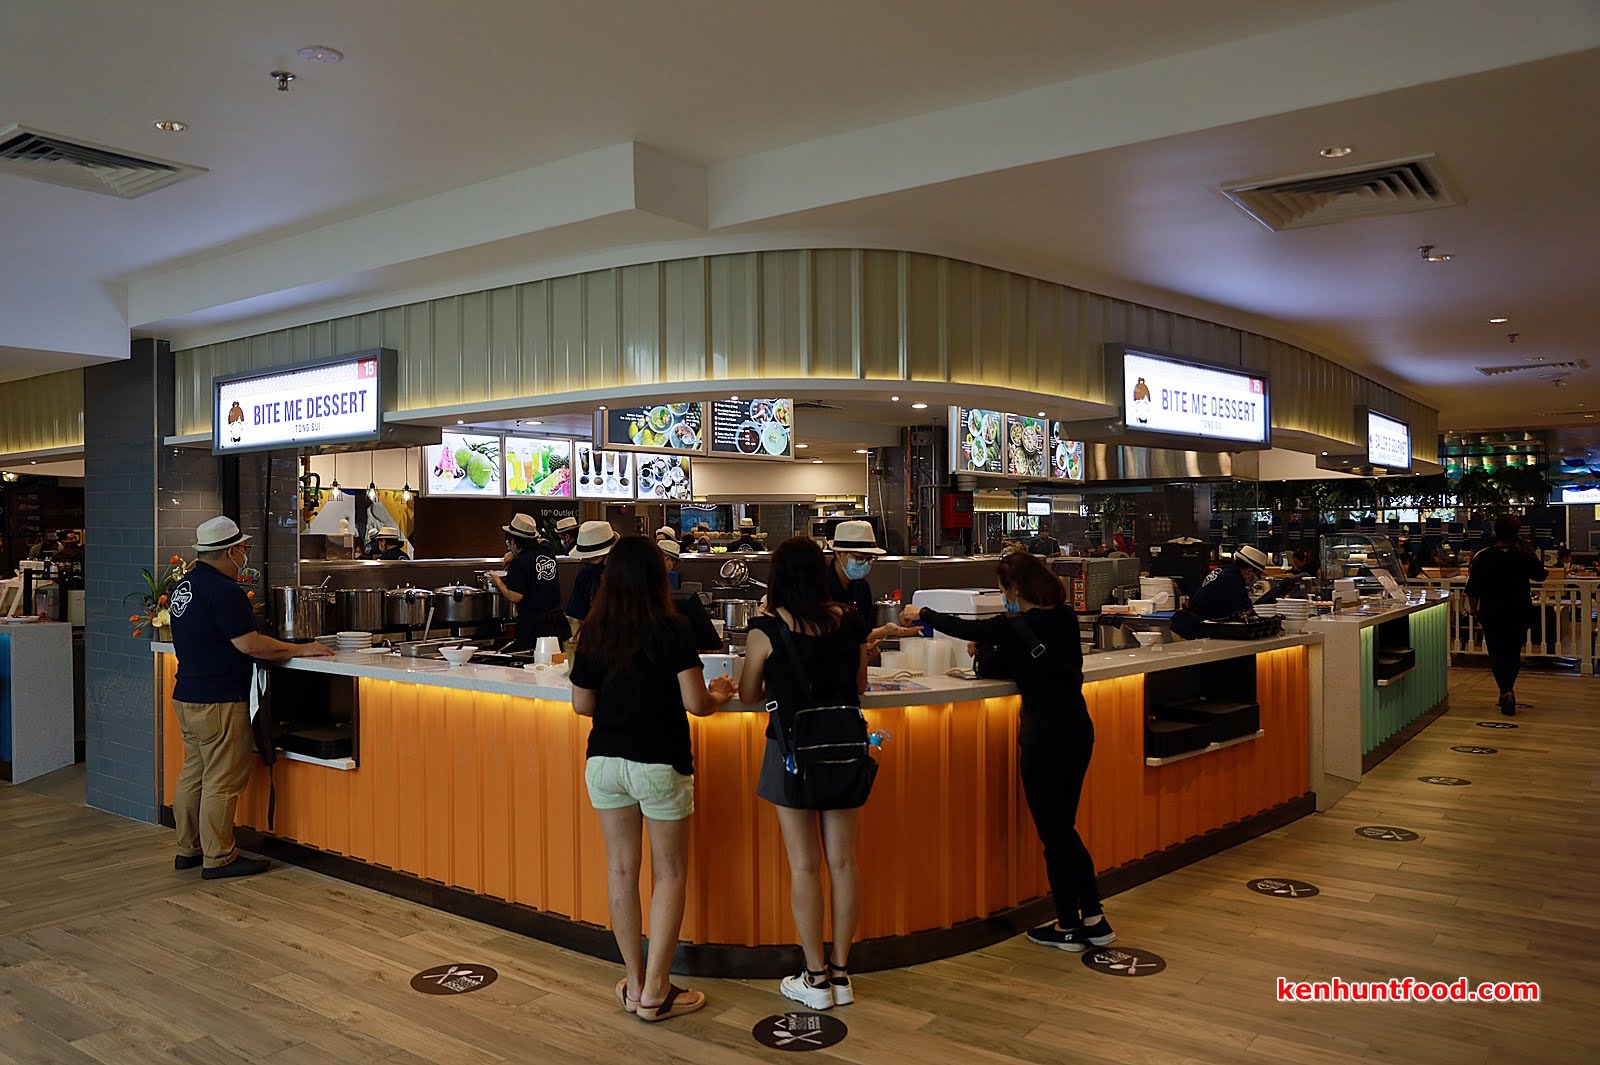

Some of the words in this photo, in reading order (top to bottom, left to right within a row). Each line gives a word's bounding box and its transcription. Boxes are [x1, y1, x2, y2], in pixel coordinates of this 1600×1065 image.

[364, 361, 374, 376] 15
[1252, 379, 1260, 392] 15
[253, 402, 280, 425] BITE
[284, 399, 303, 422] ME
[306, 390, 367, 419] DESSERT
[1161, 389, 1187, 412] BITE
[1191, 393, 1207, 416] ME
[1211, 396, 1256, 422] DESSERT
[295, 424, 310, 433] TONG
[311, 422, 321, 432] SUI
[553, 509, 574, 517] Outlet
